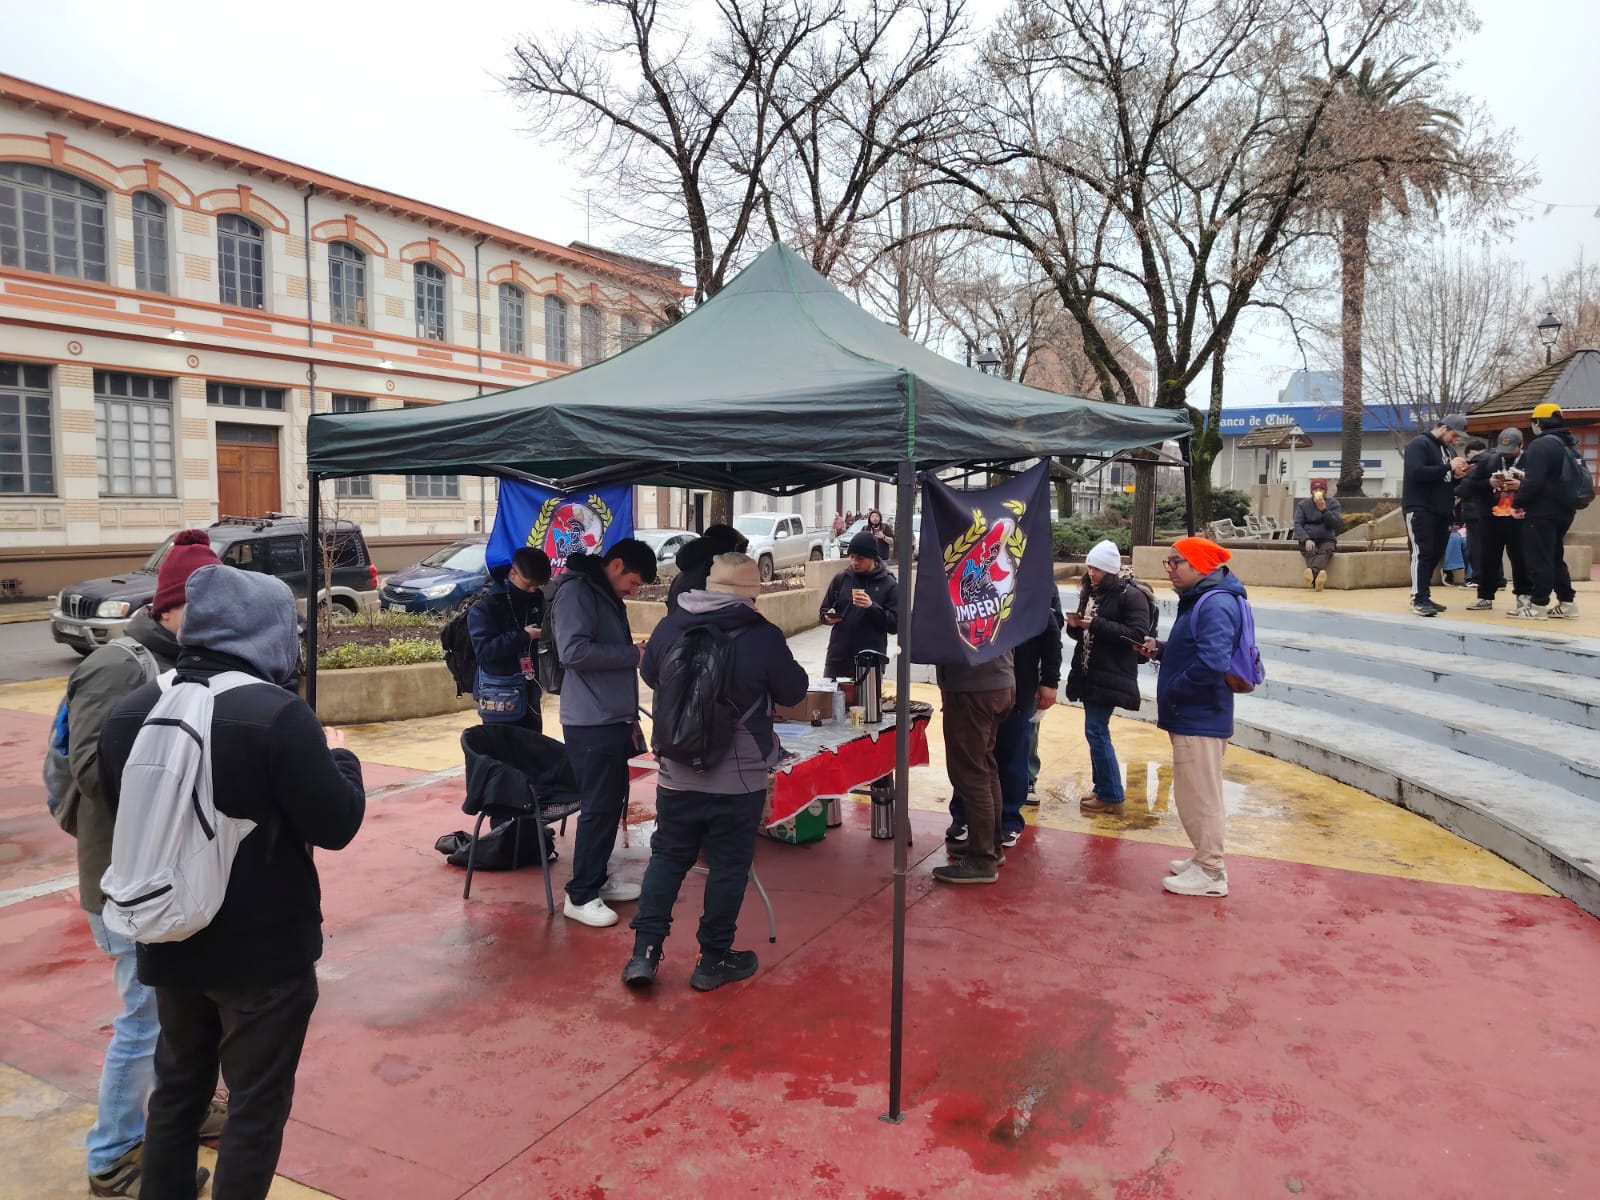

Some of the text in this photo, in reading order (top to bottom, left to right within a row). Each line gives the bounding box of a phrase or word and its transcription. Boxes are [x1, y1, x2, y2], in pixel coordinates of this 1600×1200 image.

[1220, 413, 1296, 427] anco de Chile
